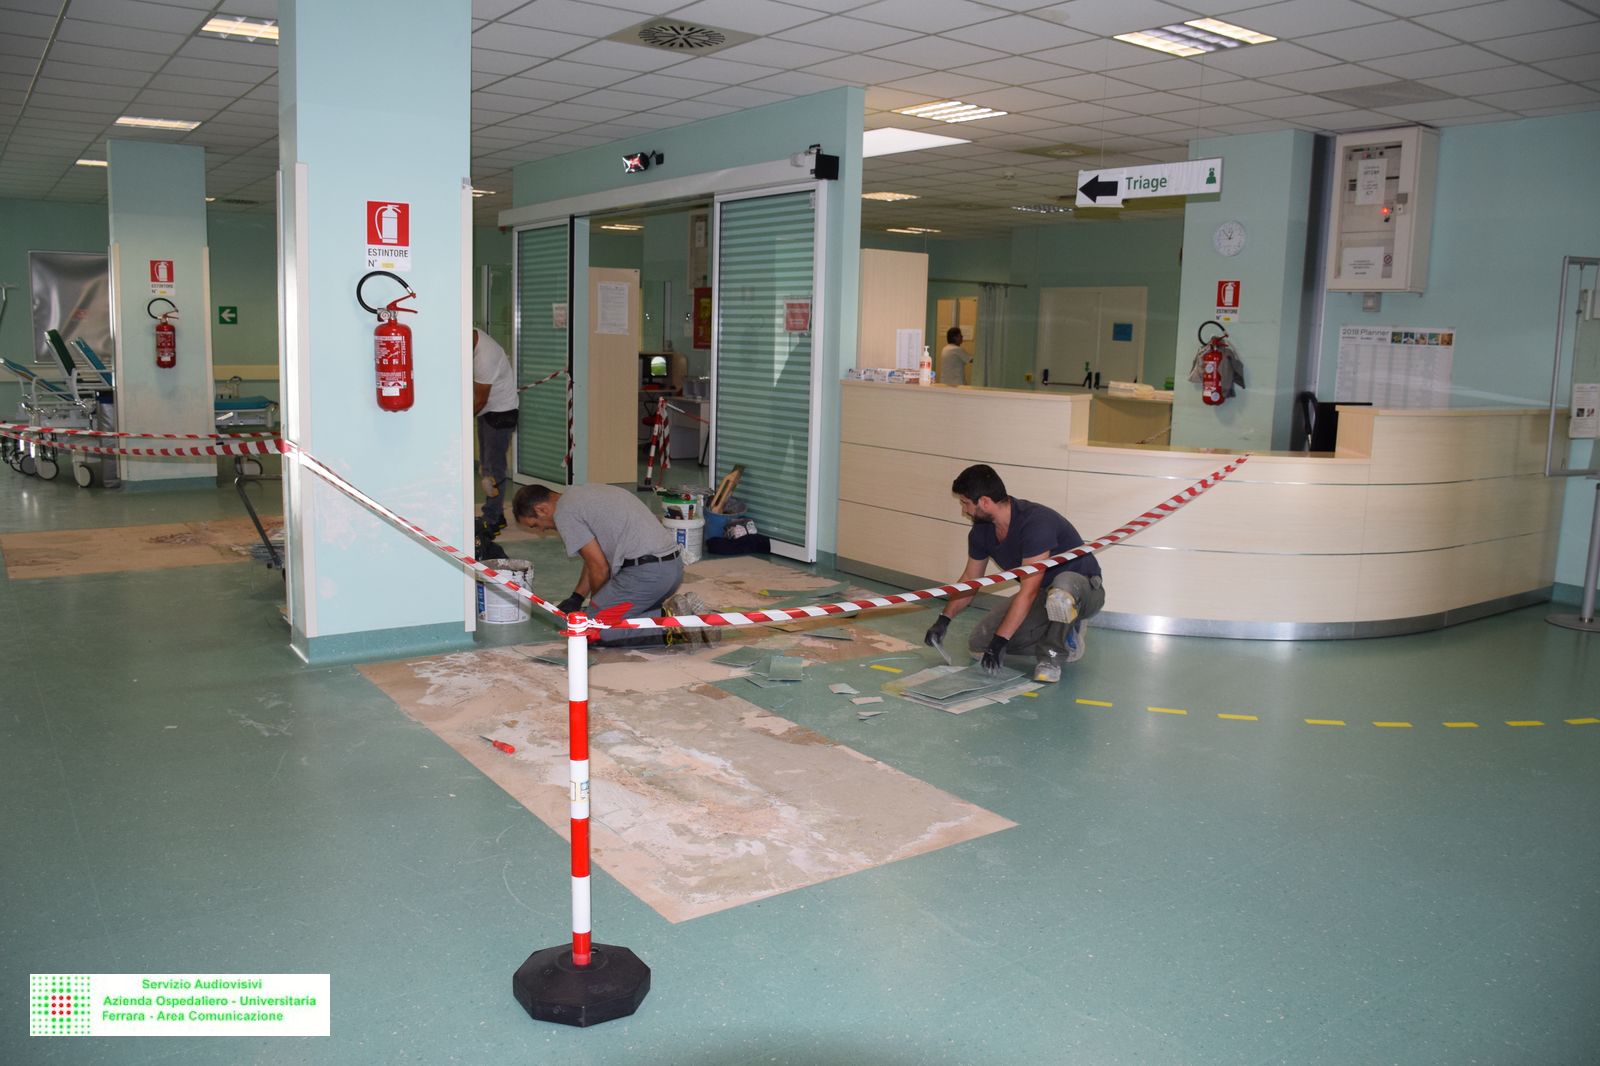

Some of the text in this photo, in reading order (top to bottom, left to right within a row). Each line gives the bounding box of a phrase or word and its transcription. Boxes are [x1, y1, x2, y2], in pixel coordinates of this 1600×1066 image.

[1125, 175, 1168, 192] Triage
[368, 248, 409, 257] ESTINTORE
[1360, 328, 1390, 336] Planner
